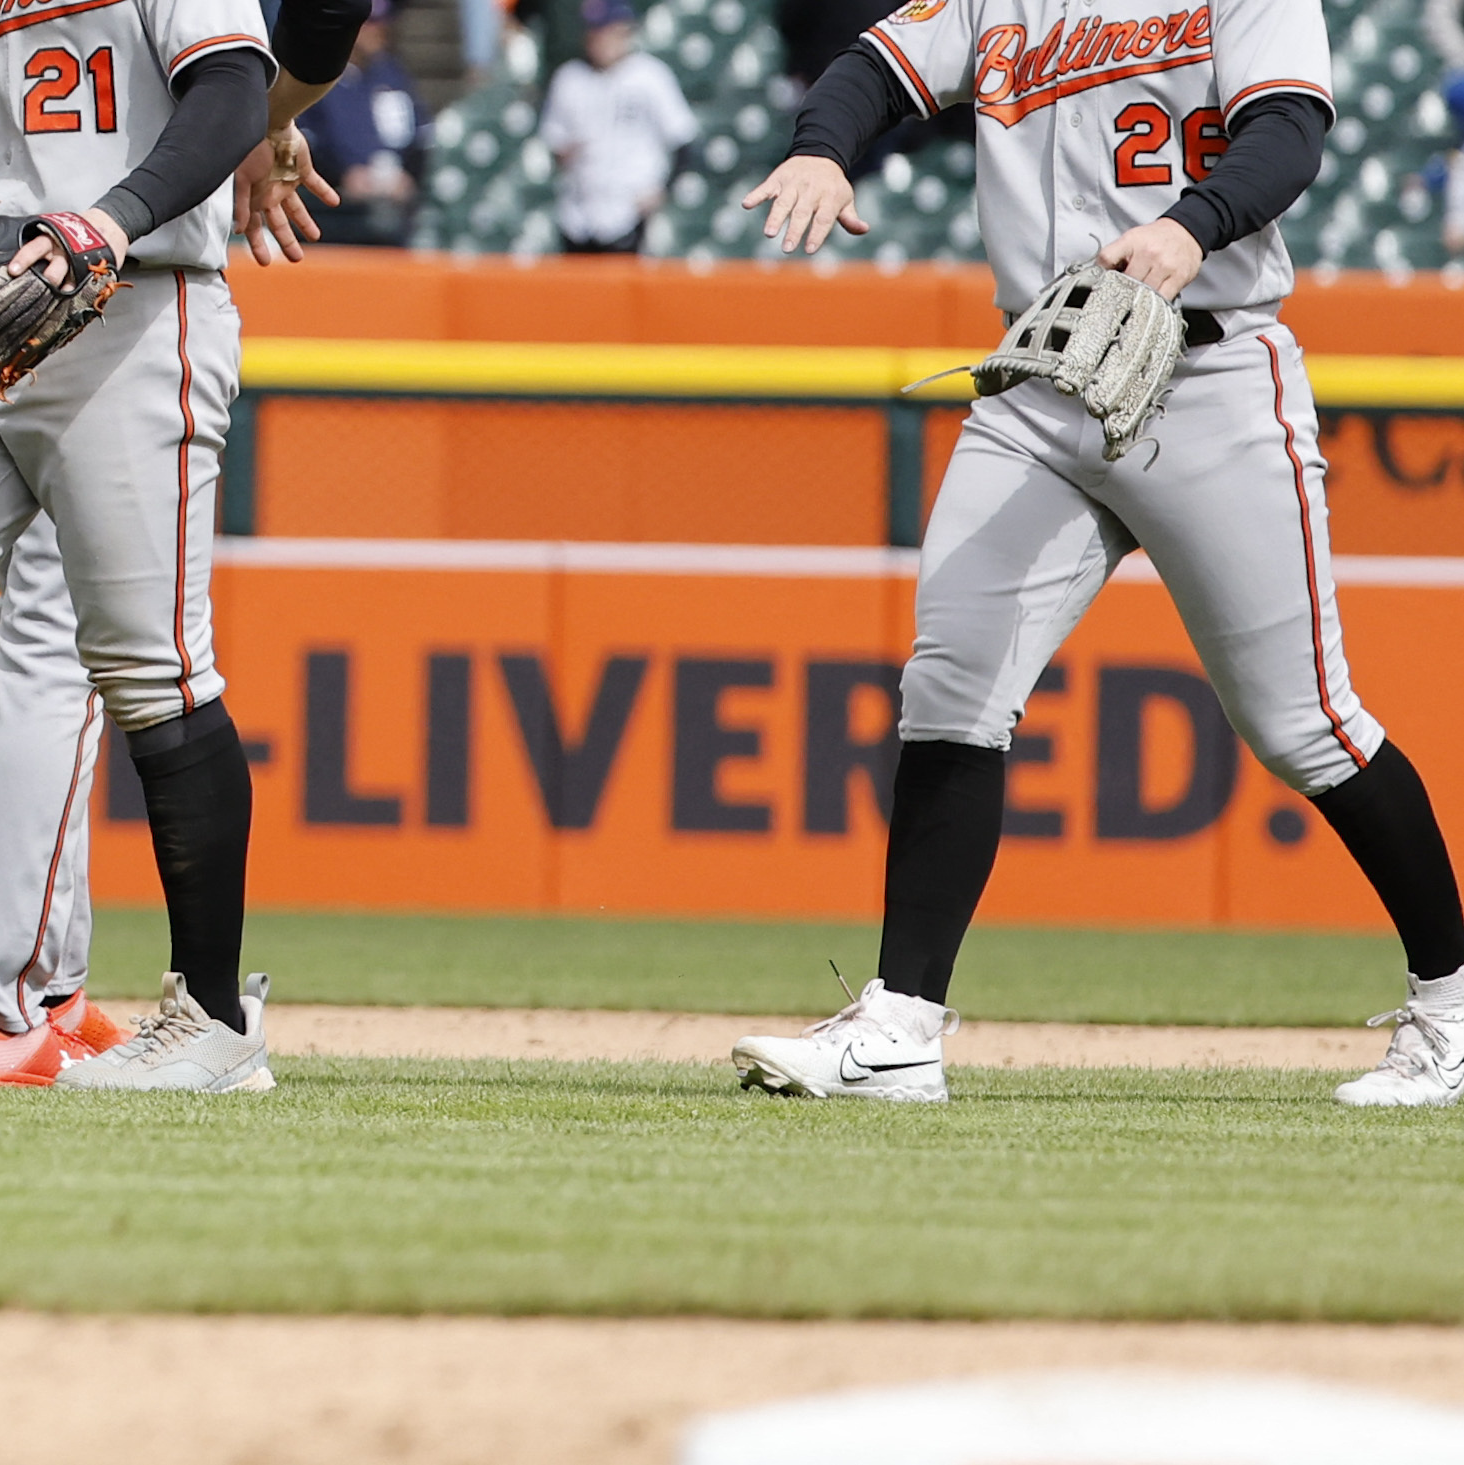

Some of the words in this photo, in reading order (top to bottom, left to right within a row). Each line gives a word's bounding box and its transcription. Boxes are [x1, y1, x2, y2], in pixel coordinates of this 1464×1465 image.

[24, 46, 118, 134] 21
[974, 5, 1212, 106] Baltimore
[1114, 102, 1230, 188] 26
